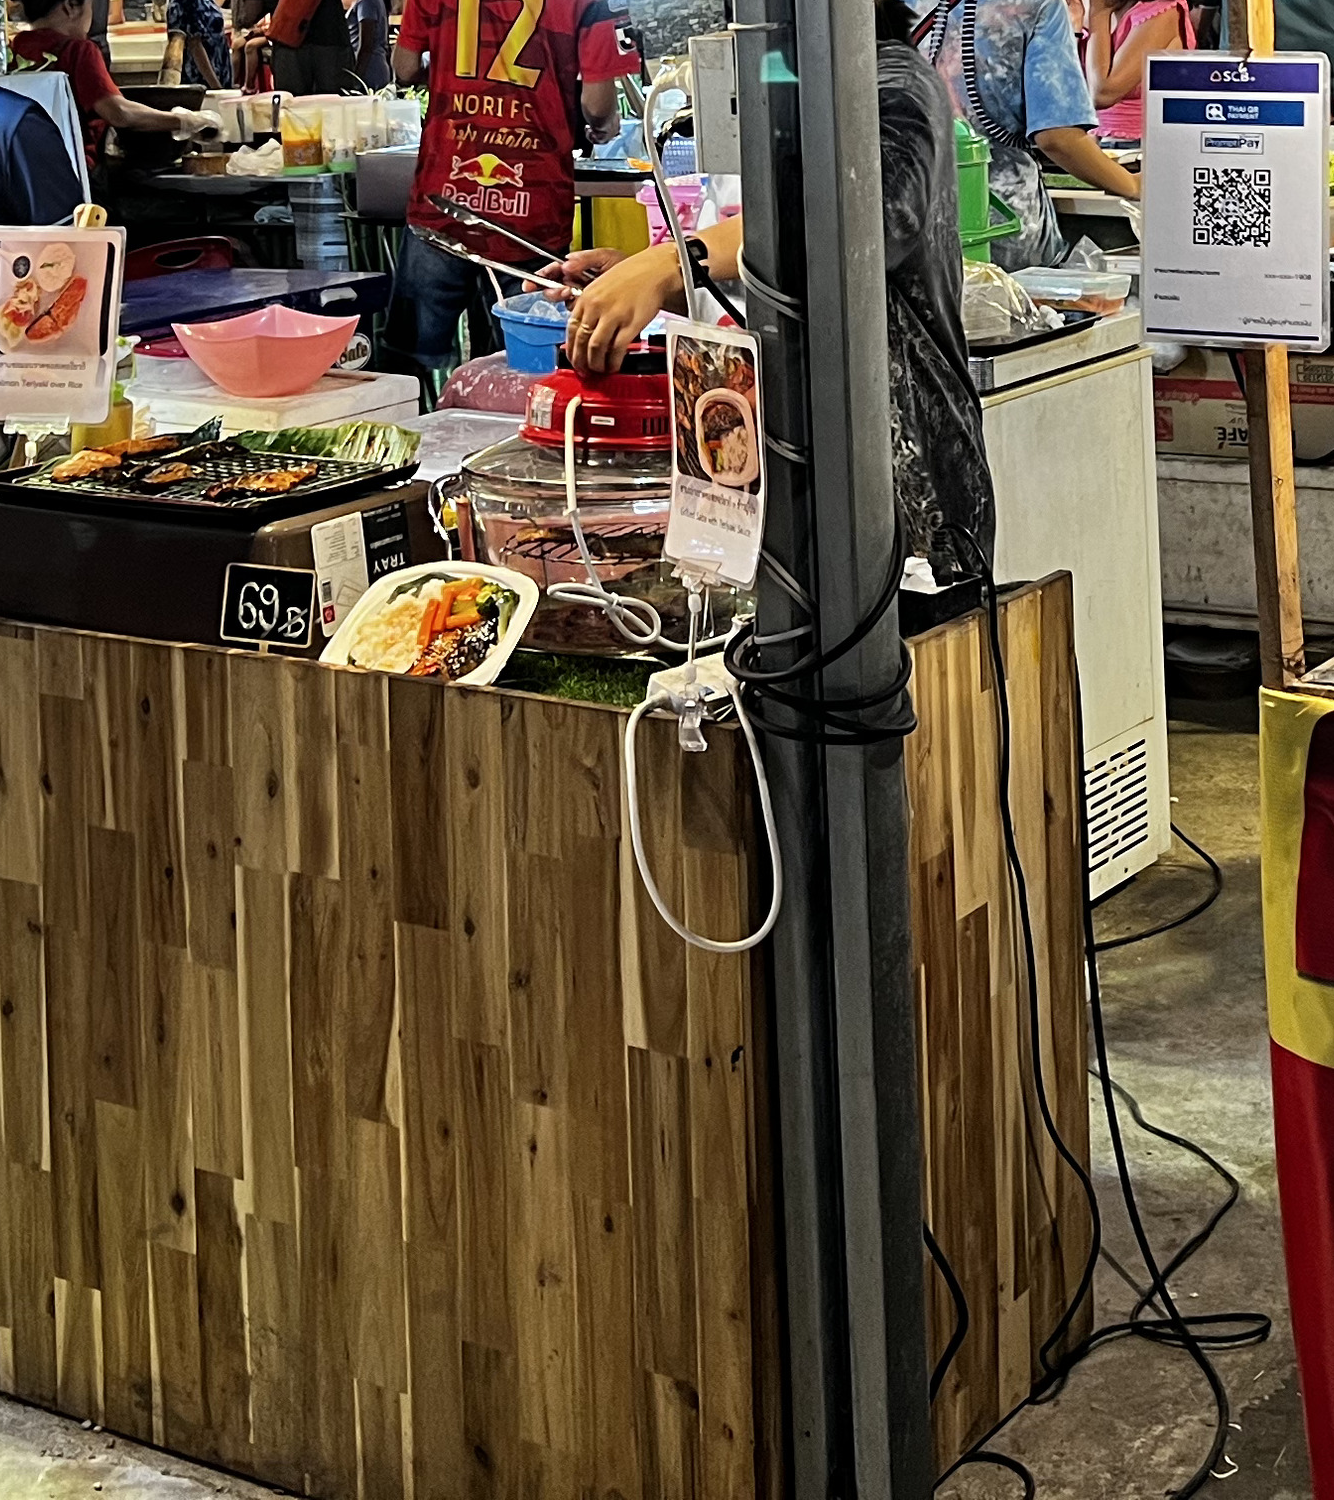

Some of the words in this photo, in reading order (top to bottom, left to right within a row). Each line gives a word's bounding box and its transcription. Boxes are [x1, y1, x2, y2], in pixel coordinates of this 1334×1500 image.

[453, 93, 503, 117] NORI
[511, 101, 534, 122] FC
[485, 188, 530, 217] Bull
[373, 552, 406, 574] TRAY
